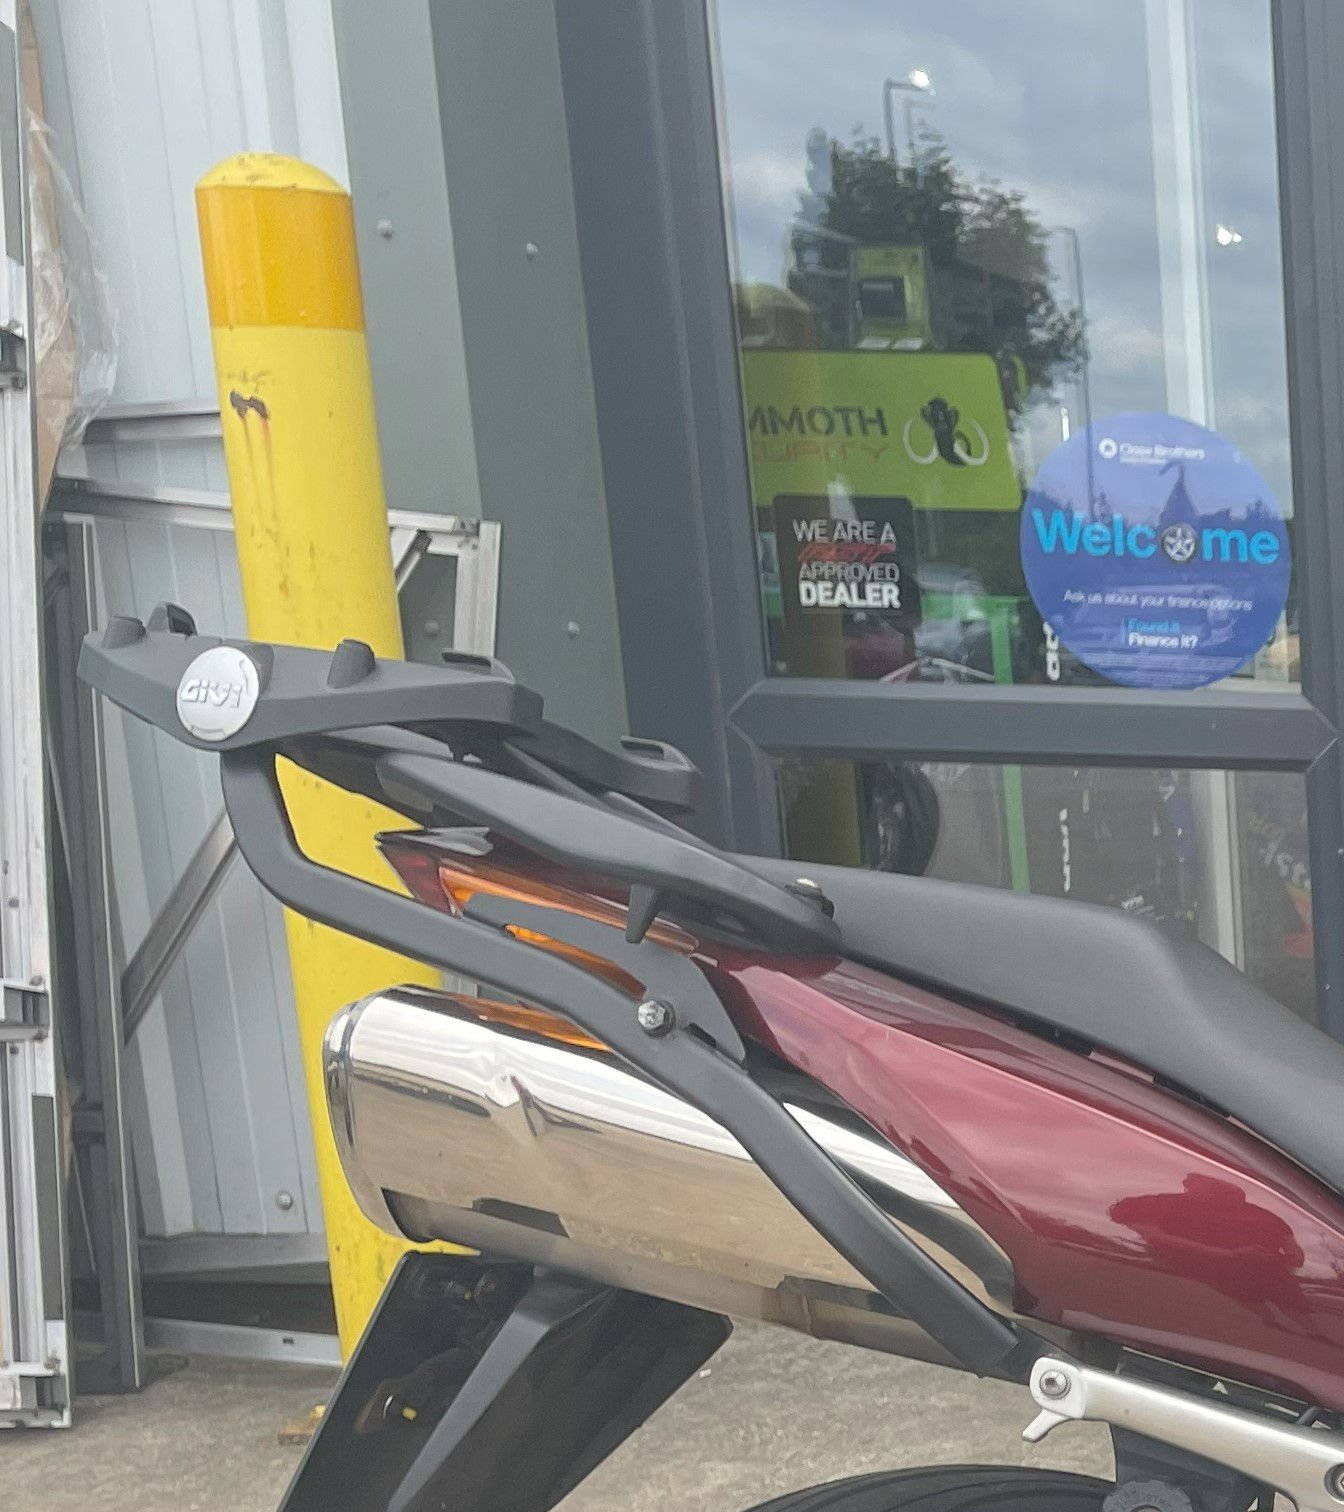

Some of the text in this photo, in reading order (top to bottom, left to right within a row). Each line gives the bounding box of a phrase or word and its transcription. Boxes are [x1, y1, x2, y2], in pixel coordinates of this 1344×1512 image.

[793, 519, 896, 544] WE ARE A
[799, 560, 901, 582] APPROVED
[799, 580, 901, 608] DEALER
